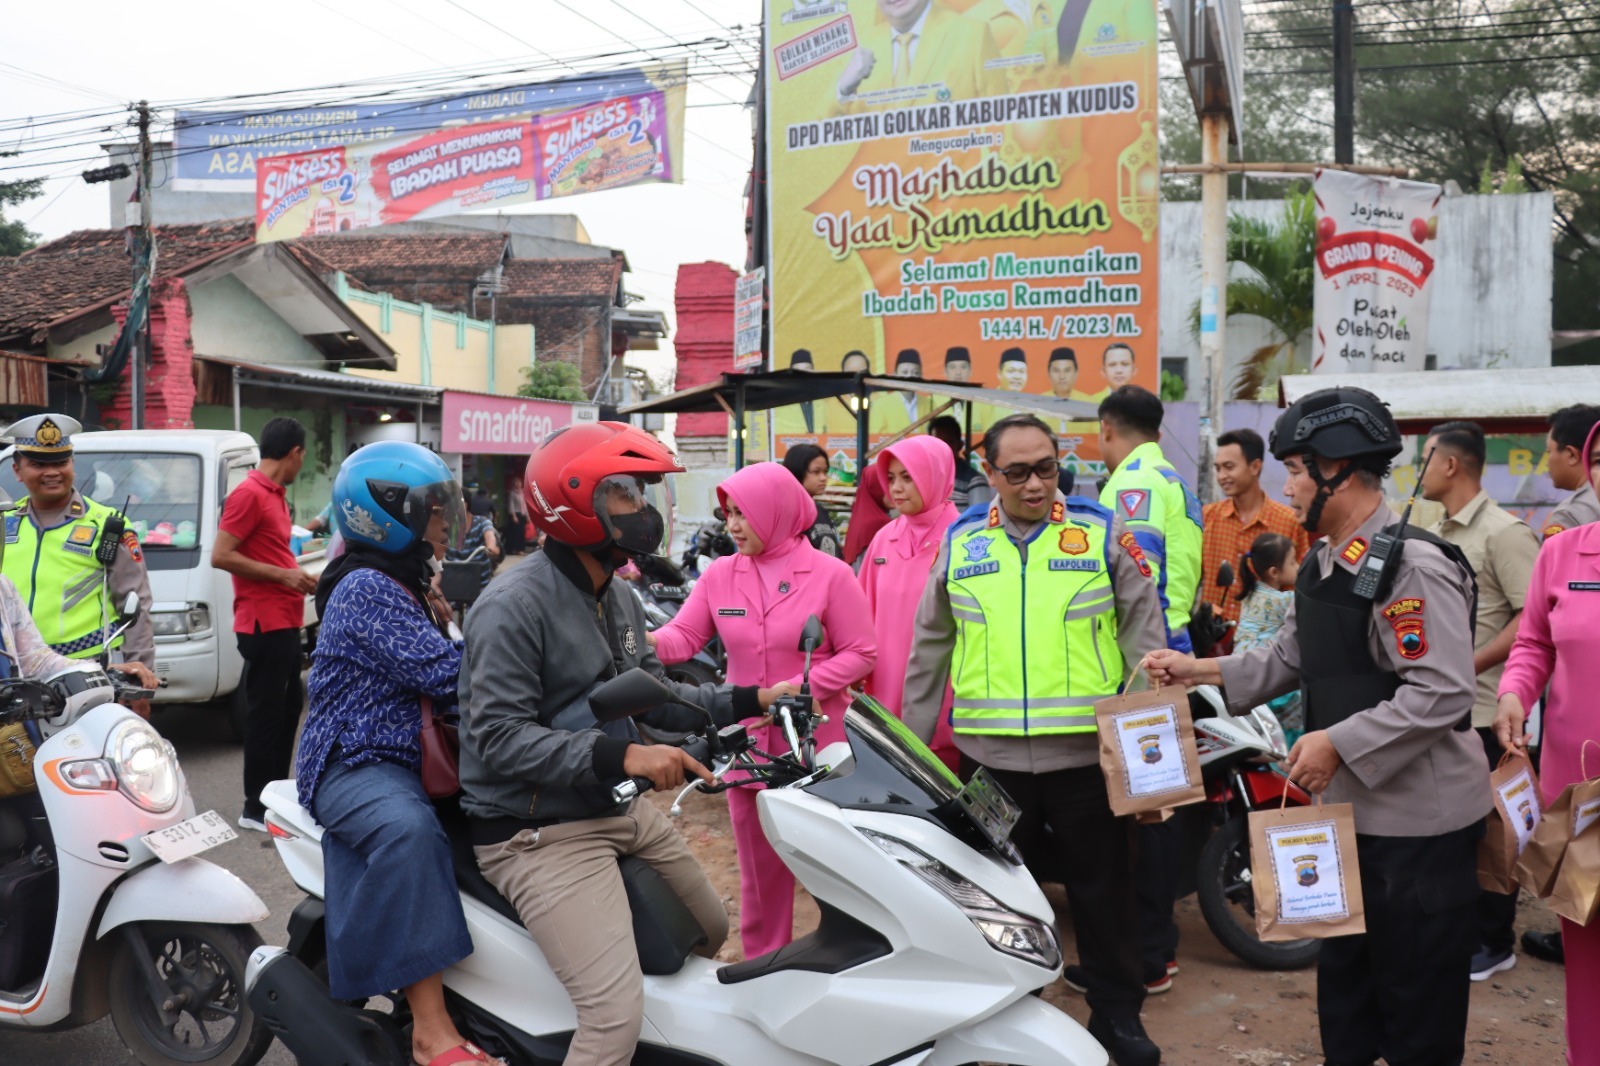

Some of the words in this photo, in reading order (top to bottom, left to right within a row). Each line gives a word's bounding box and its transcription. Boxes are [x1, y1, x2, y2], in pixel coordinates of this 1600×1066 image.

[780, 38, 813, 63] GOLKAR
[812, 22, 848, 47] MENANG
[783, 54, 808, 72] RAKYAT
[809, 36, 849, 60] SEJAHTERA
[788, 122, 820, 149] DPD
[824, 114, 879, 144] PARTAI
[883, 105, 950, 136] GOLKAR
[956, 94, 1061, 127] KABUPATEN
[1066, 84, 1134, 114] KUDUS
[387, 145, 438, 175] SELAMAT
[439, 127, 523, 156] MENUNAIKAN
[910, 133, 993, 154] Mengucapkan
[390, 157, 458, 198] IBADAH
[460, 146, 521, 177] PUASA
[856, 157, 1056, 206] Marhaban
[1351, 202, 1404, 221] Jajanku
[815, 213, 892, 256] Yaa
[897, 197, 1107, 249] Ramadhan
[901, 258, 987, 284] Selamat
[993, 248, 1139, 277] Menunaikan
[1323, 242, 1372, 269] GRAND
[864, 288, 935, 315] Ibadah
[943, 286, 1006, 311] Puasa
[1014, 278, 1139, 306] Ramadhan
[1386, 276, 1415, 298] 2023
[981, 319, 1022, 339] 1444
[1029, 318, 1046, 336] H.
[1066, 315, 1110, 336] 2023
[1116, 315, 1139, 333] M.
[1336, 317, 1410, 341] Oleh-Oleh
[1340, 342, 1366, 360] dan
[459, 403, 552, 443] smartfren
[957, 562, 996, 579] DYDIT
[1053, 560, 1098, 570] KAPOLRES
[1385, 600, 1420, 616] POLRES
[143, 837, 162, 850] K
[161, 822, 200, 843] 5312
